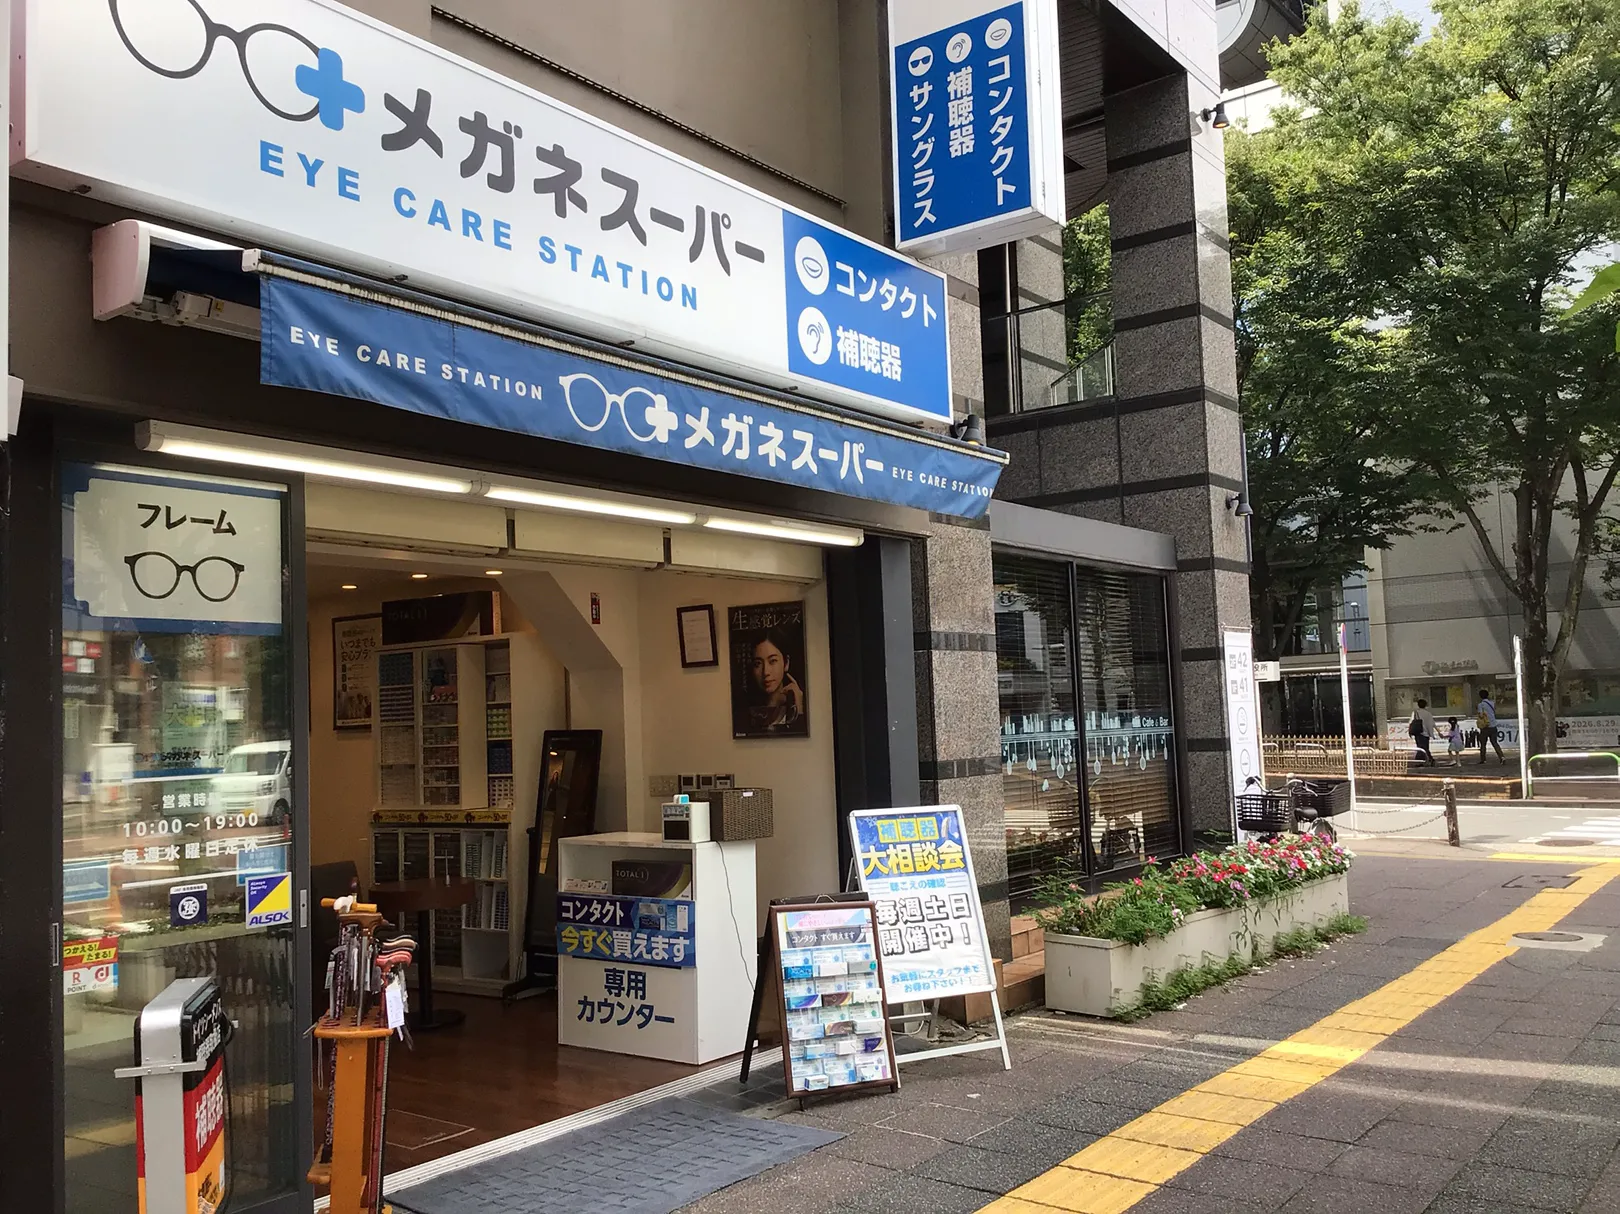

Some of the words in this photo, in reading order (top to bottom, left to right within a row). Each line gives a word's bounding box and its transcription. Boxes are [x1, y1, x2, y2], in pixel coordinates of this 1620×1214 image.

[947, 65, 975, 158] 補聴器
[988, 54, 1016, 206] コンタクト
[909, 81, 937, 228] サングラス
[381, 88, 765, 276] メガネスーパー
[260, 140, 361, 202] EYE
[393, 187, 511, 250] CARE
[539, 236, 698, 310] STATION
[835, 263, 937, 327] コンタクト
[290, 327, 339, 355] EYE
[356, 345, 427, 374] CARE
[441, 364, 543, 400] STATION
[836, 325, 902, 381] 補聴器
[684, 406, 884, 484] メガネスーパー
[892, 466, 913, 481] EYE
[919, 472, 947, 489] CARE
[137, 503, 237, 536] フレーム
[1237, 652, 1248, 668] 42
[1239, 677, 1249, 693] 41
[880, 820, 936, 840] 補聴器
[615, 870, 639, 878] TOTAL
[860, 839, 966, 876] 大相談会
[249, 912, 289, 926] ALSOK
[561, 900, 624, 926] コンタクト
[875, 893, 972, 926] 毎週土日
[560, 926, 690, 963] 今すぐ買えます
[792, 934, 818, 943] コンタクト
[820, 931, 856, 941] すぐ買えます
[604, 967, 647, 1000] 専用
[577, 996, 675, 1029] カウンター
